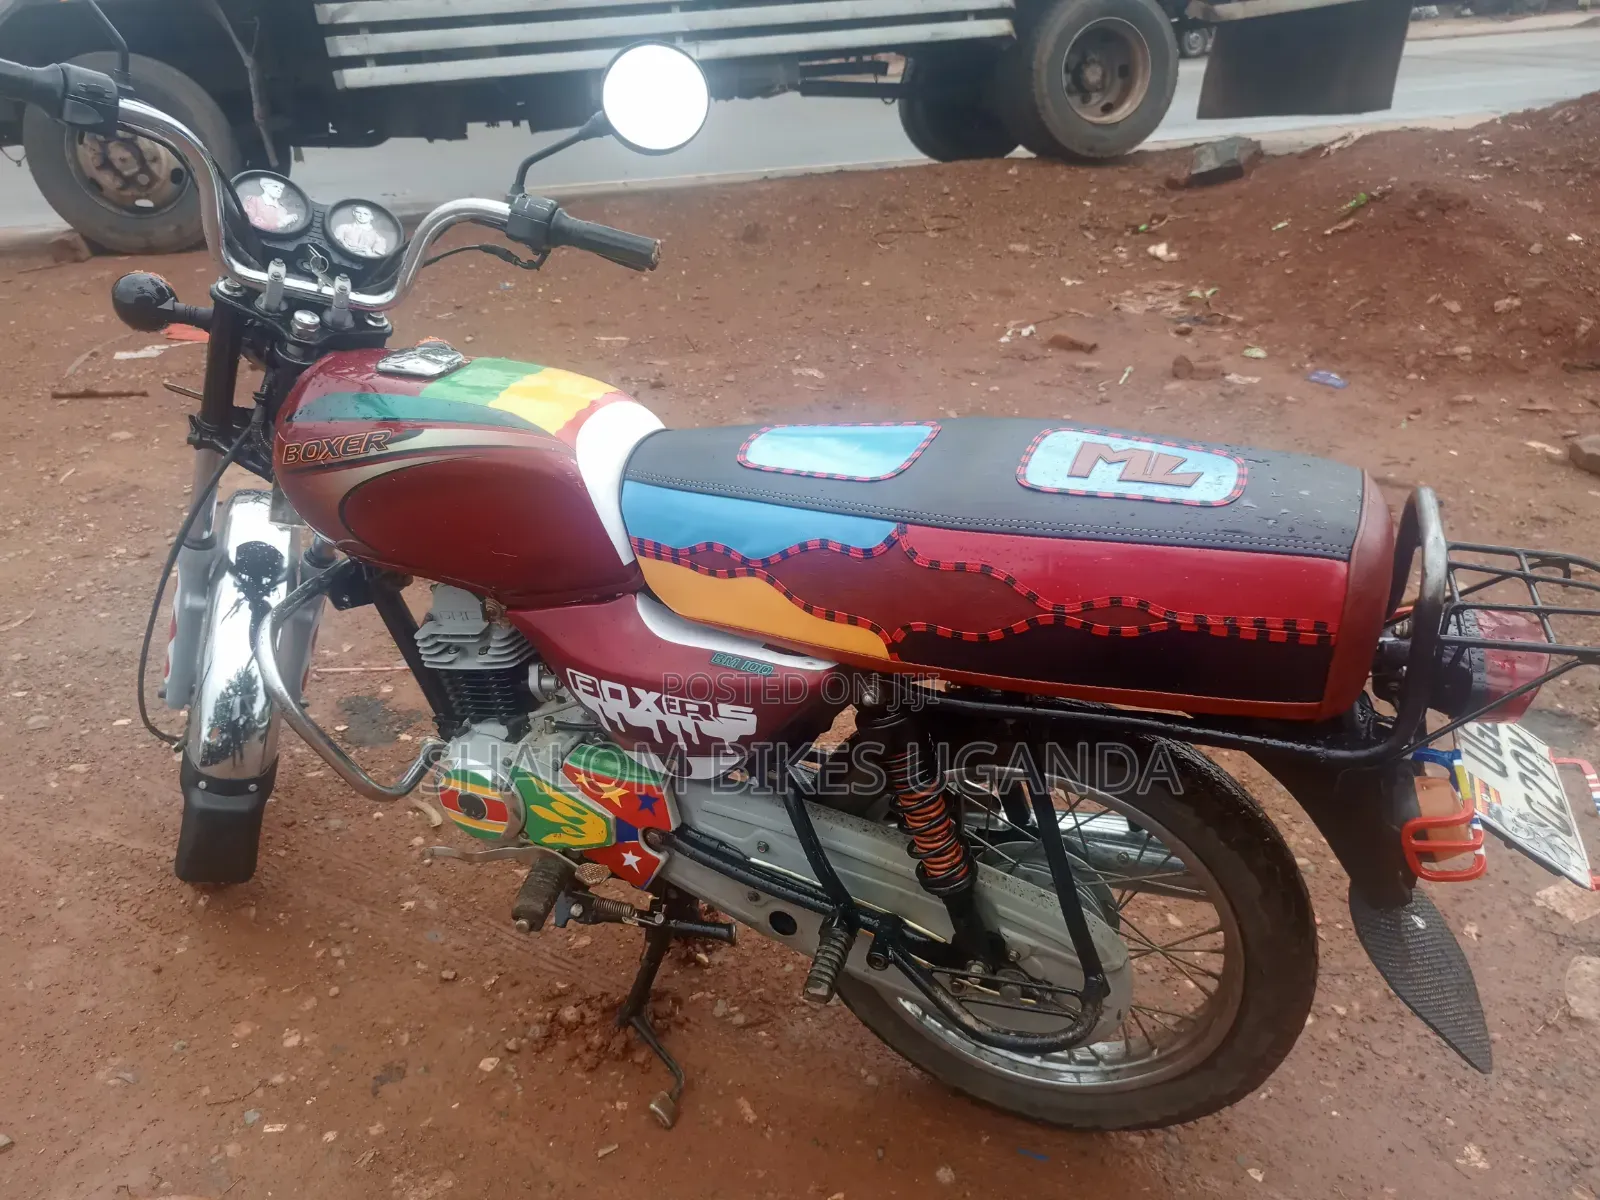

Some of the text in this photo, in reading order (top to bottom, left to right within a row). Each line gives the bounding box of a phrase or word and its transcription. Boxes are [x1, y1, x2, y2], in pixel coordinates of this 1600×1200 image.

[283, 429, 394, 464] BOXER
[711, 653, 774, 675] BM 100
[566, 668, 757, 754] BOXERS
